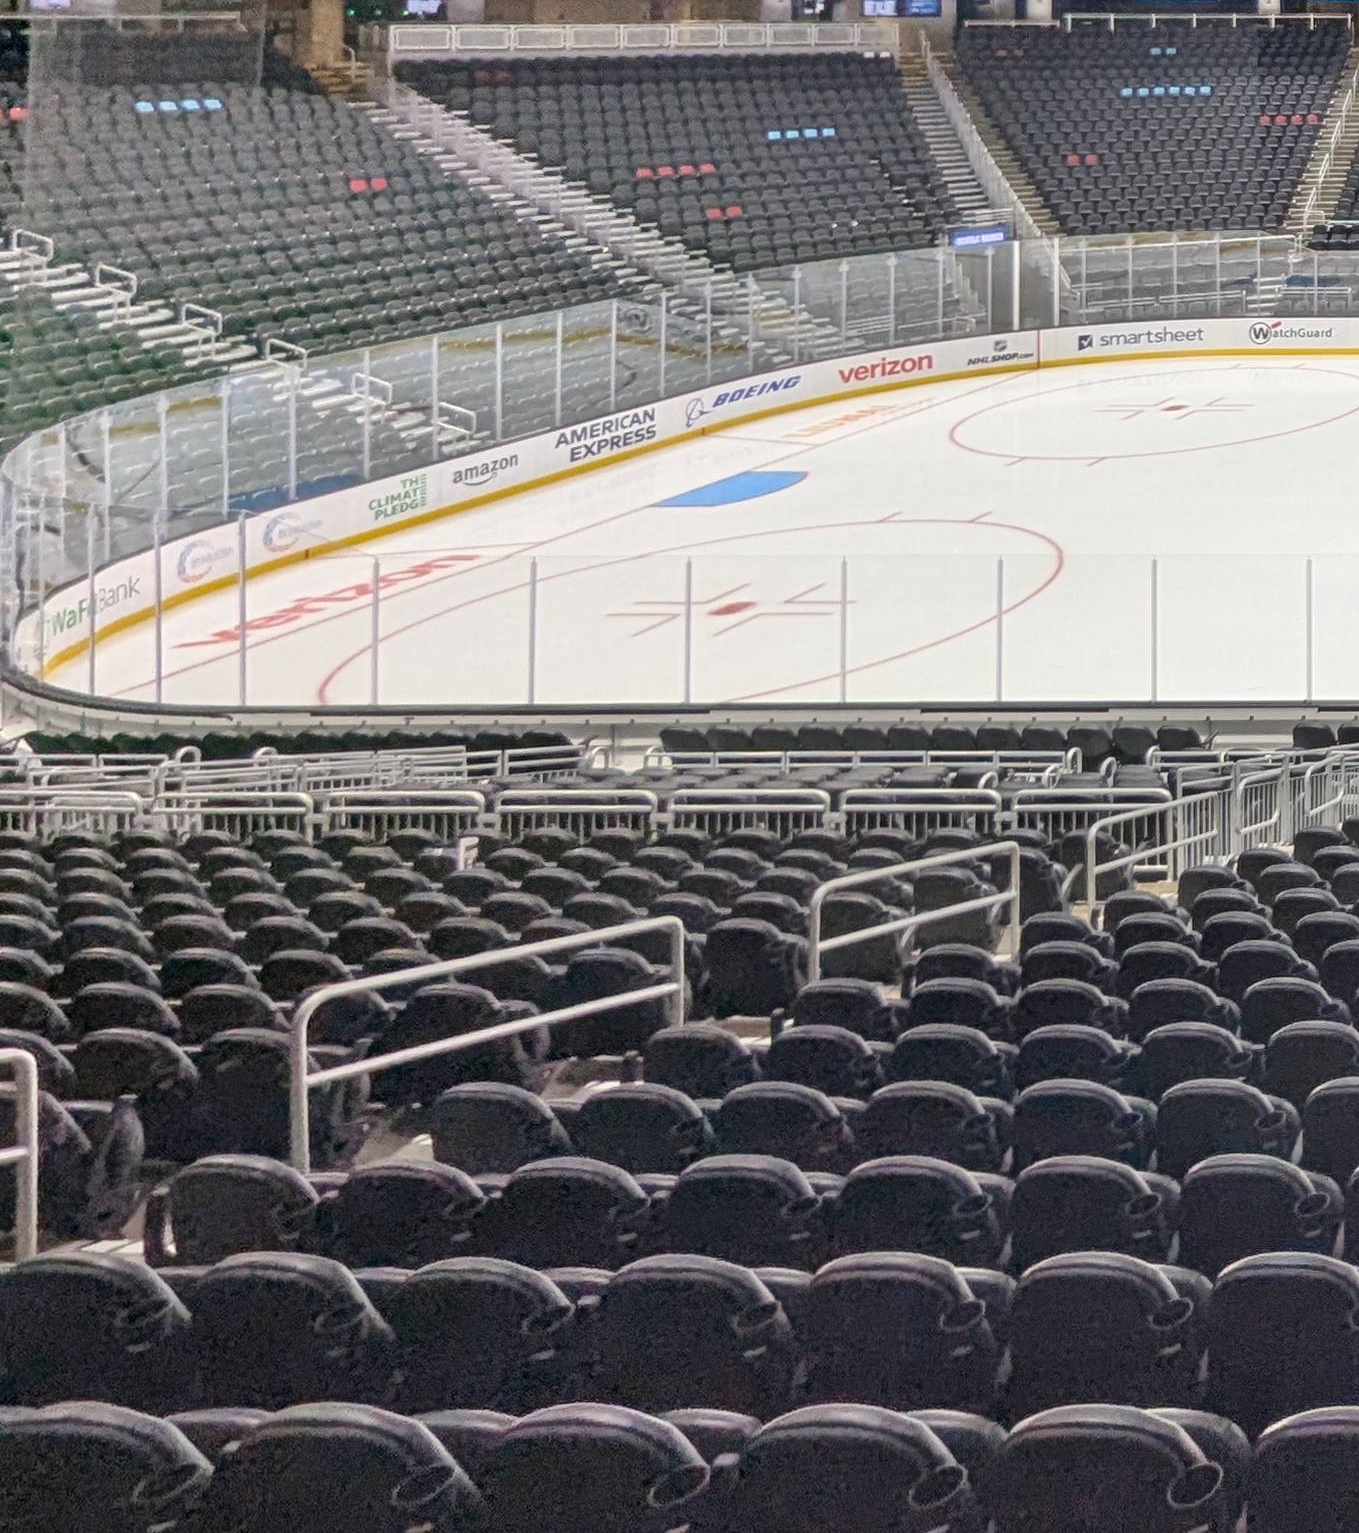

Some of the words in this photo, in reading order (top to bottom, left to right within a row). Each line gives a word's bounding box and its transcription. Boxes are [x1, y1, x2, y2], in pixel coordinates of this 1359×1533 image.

[1100, 326, 1204, 347] smartsheet
[1249, 322, 1333, 344] WatchGuard
[838, 353, 934, 385] verizon
[712, 375, 802, 409] BOEING
[554, 408, 656, 449] AMERICAN
[570, 425, 657, 463] EXPRESS
[400, 473, 428, 489] THE
[452, 452, 519, 486] amazon
[368, 485, 428, 512] CLIMATE
[374, 499, 428, 520] PLEDGE
